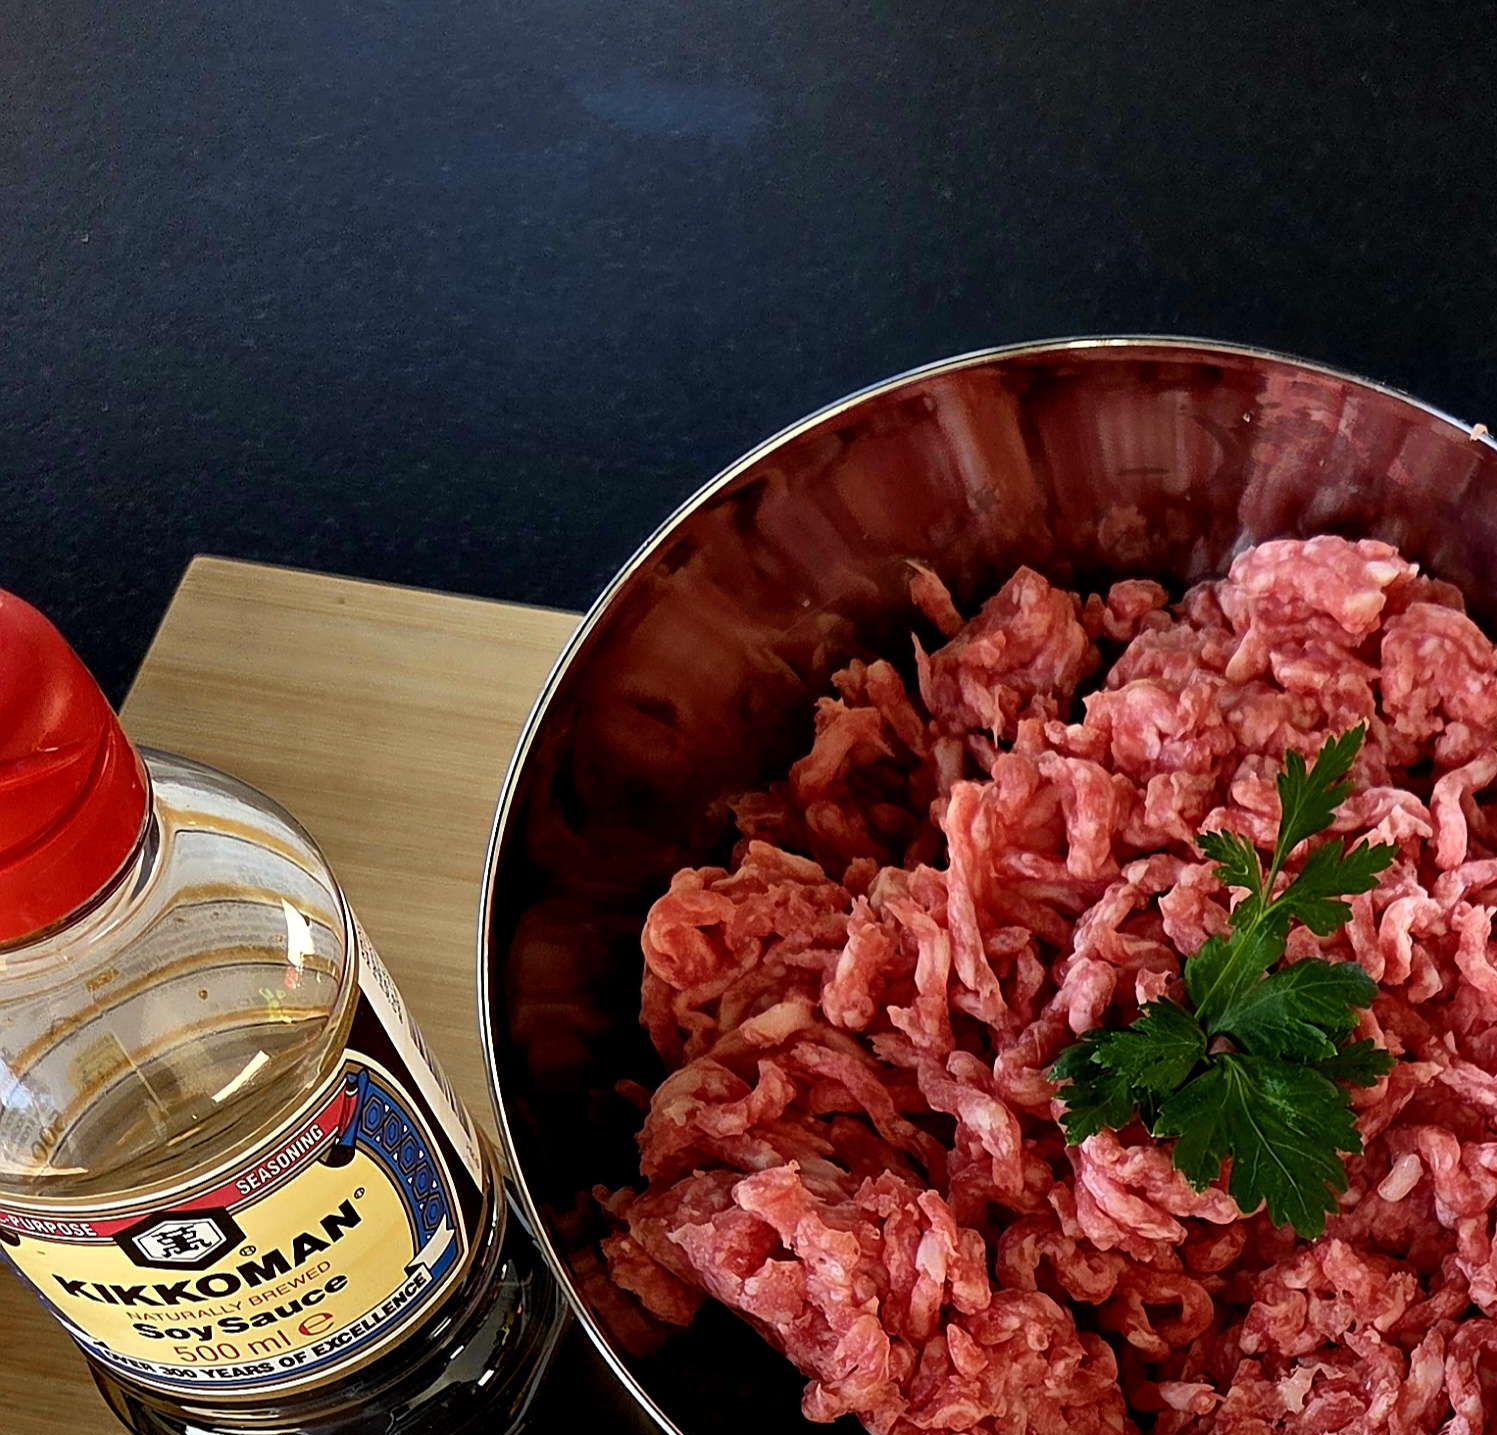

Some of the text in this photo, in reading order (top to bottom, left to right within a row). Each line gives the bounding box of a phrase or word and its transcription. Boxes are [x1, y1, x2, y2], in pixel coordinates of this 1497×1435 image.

[235, 1124, 324, 1195] SEASONING
[0, 1214, 97, 1237] -PURPOSE
[52, 1198, 363, 1306] KIKKOMAN
[126, 1260, 331, 1321] NATURALLY BREWED
[132, 1274, 348, 1341] Soy Sauce
[103, 1272, 427, 1379] OVER 300 YEARS OF EXCELLENCE
[173, 1343, 240, 1363] 500
[248, 1329, 292, 1356] ml
